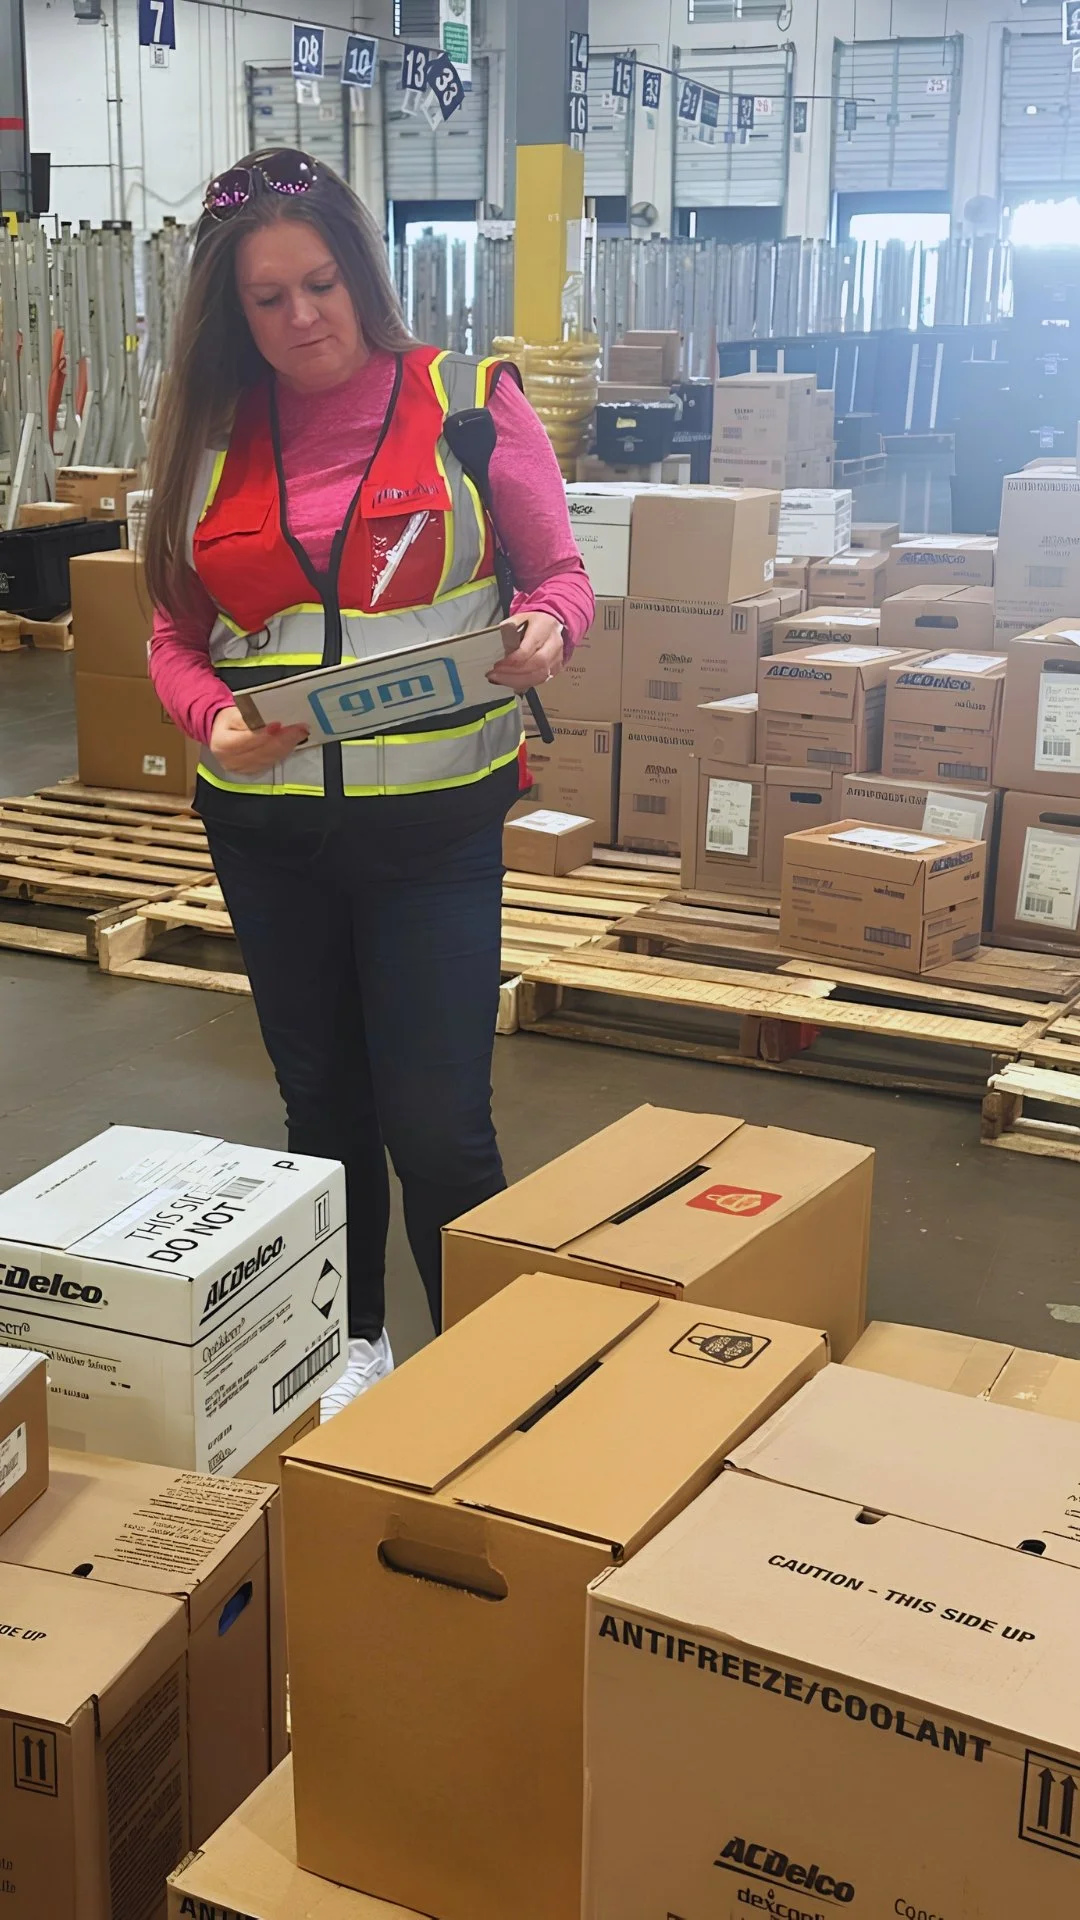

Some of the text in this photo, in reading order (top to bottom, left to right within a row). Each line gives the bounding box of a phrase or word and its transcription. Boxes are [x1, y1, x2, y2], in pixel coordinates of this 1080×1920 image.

[149, 1, 165, 43] 7
[406, 50, 426, 88] 13
[569, 31, 588, 69] 14
[616, 61, 631, 95] 15
[569, 96, 586, 130] 16
[338, 674, 436, 717] gm
[124, 1210, 184, 1241] THIS
[147, 1238, 199, 1263] DO
[183, 1201, 246, 1237] NOT
[203, 1235, 284, 1314] ACDelco
[767, 1554, 865, 1592] CAUTION
[884, 1589, 938, 1614] THIS
[939, 1607, 999, 1634] SIDE
[1000, 1625, 1037, 1644] UP
[21, 1629, 47, 1641] UP
[599, 1614, 992, 1764] ANTIFREEZE/COOLANT
[719, 1835, 856, 1904] ACDelco
